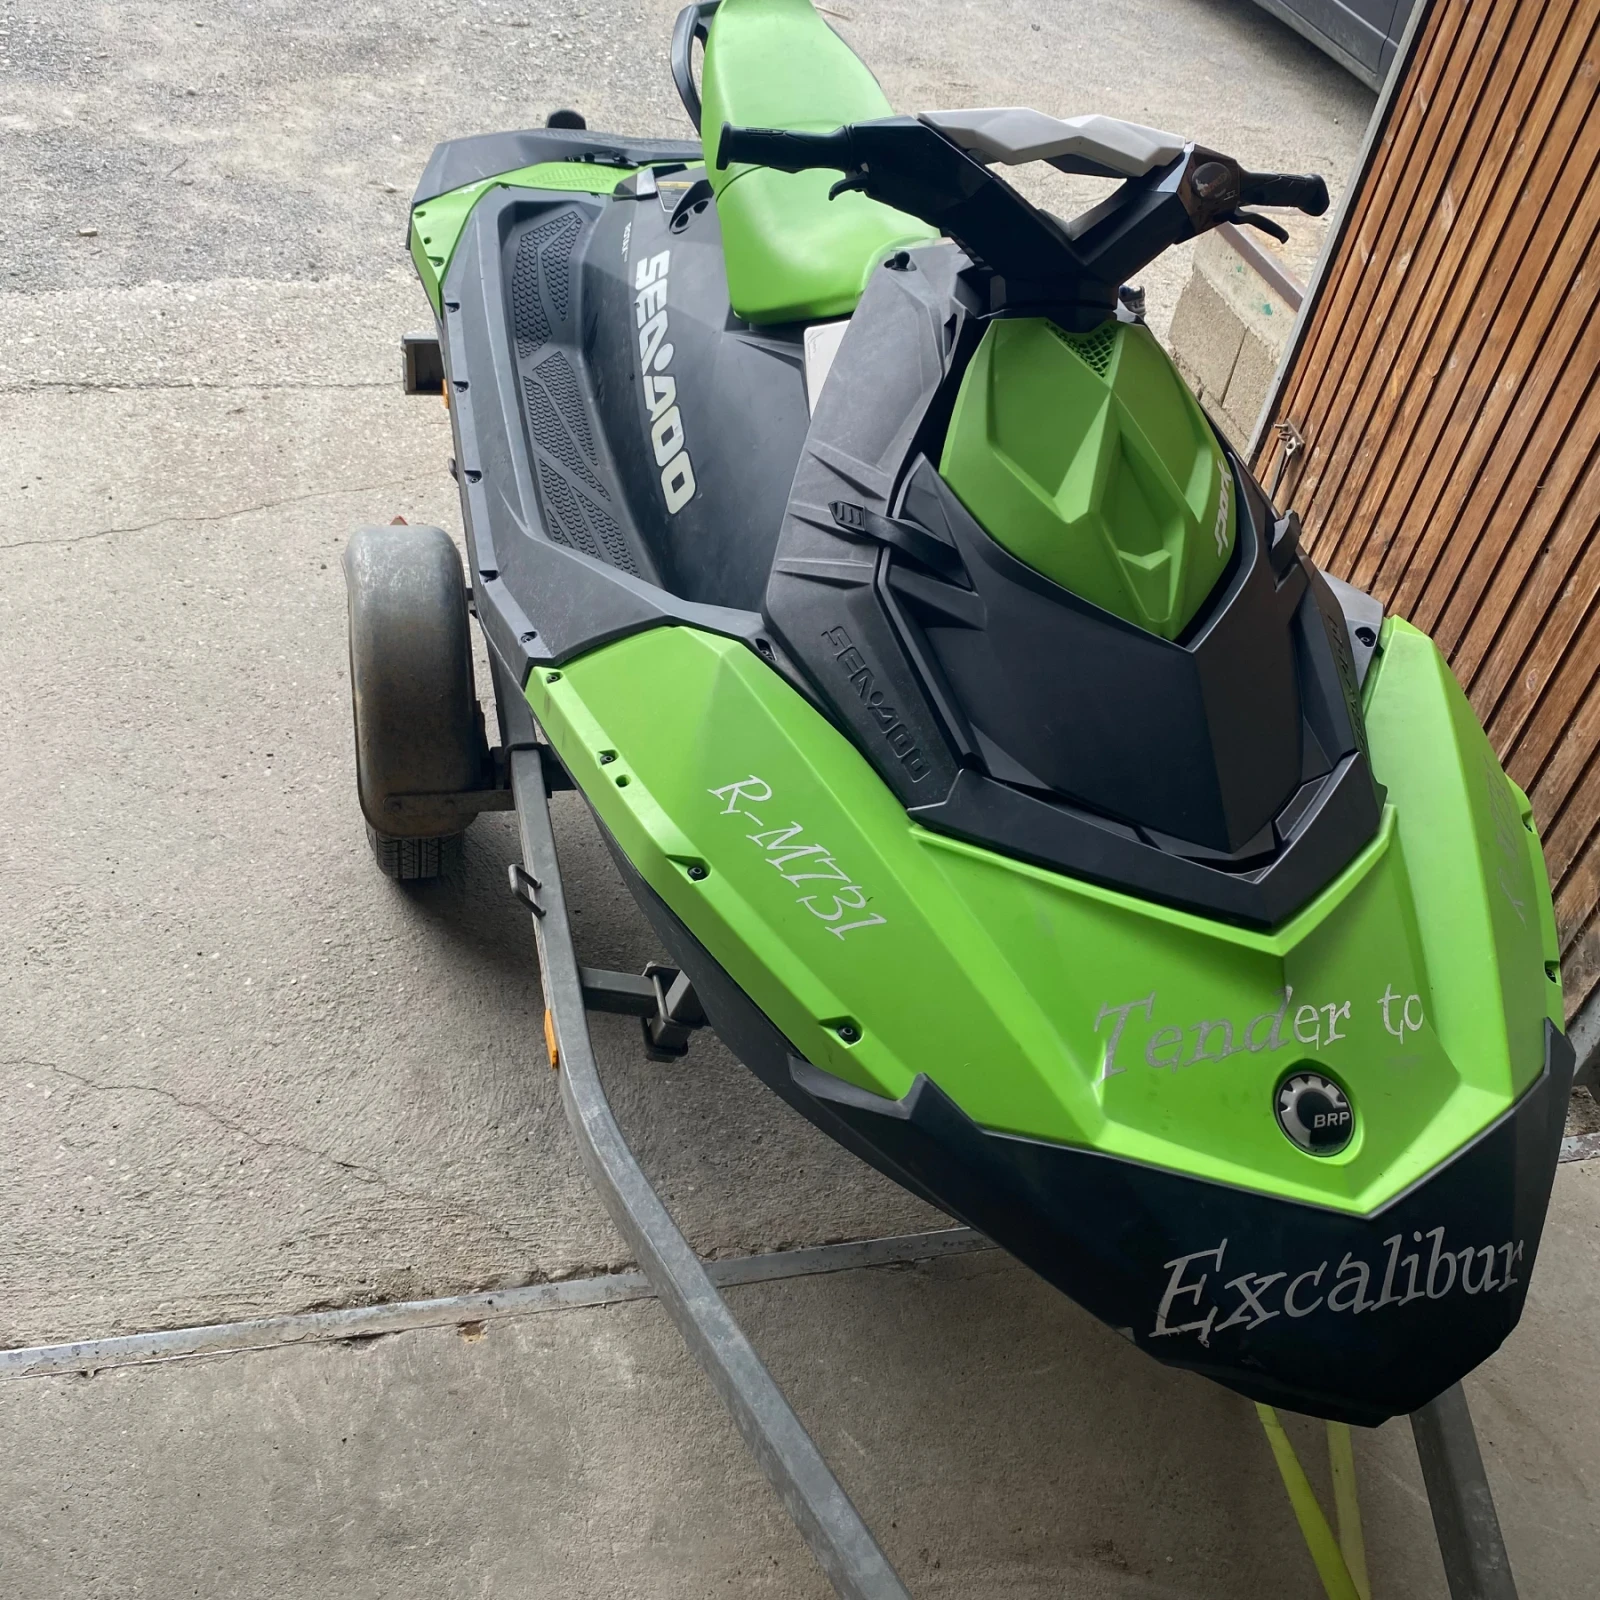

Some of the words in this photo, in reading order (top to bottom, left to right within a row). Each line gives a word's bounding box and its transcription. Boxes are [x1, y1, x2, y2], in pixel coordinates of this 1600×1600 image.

[707, 774, 887, 941] R-M731
[1093, 985, 1352, 1090] Tender
[1377, 983, 1425, 1045] to
[1313, 1112, 1351, 1129] BRP
[1148, 1226, 1525, 1348] Excalibur
